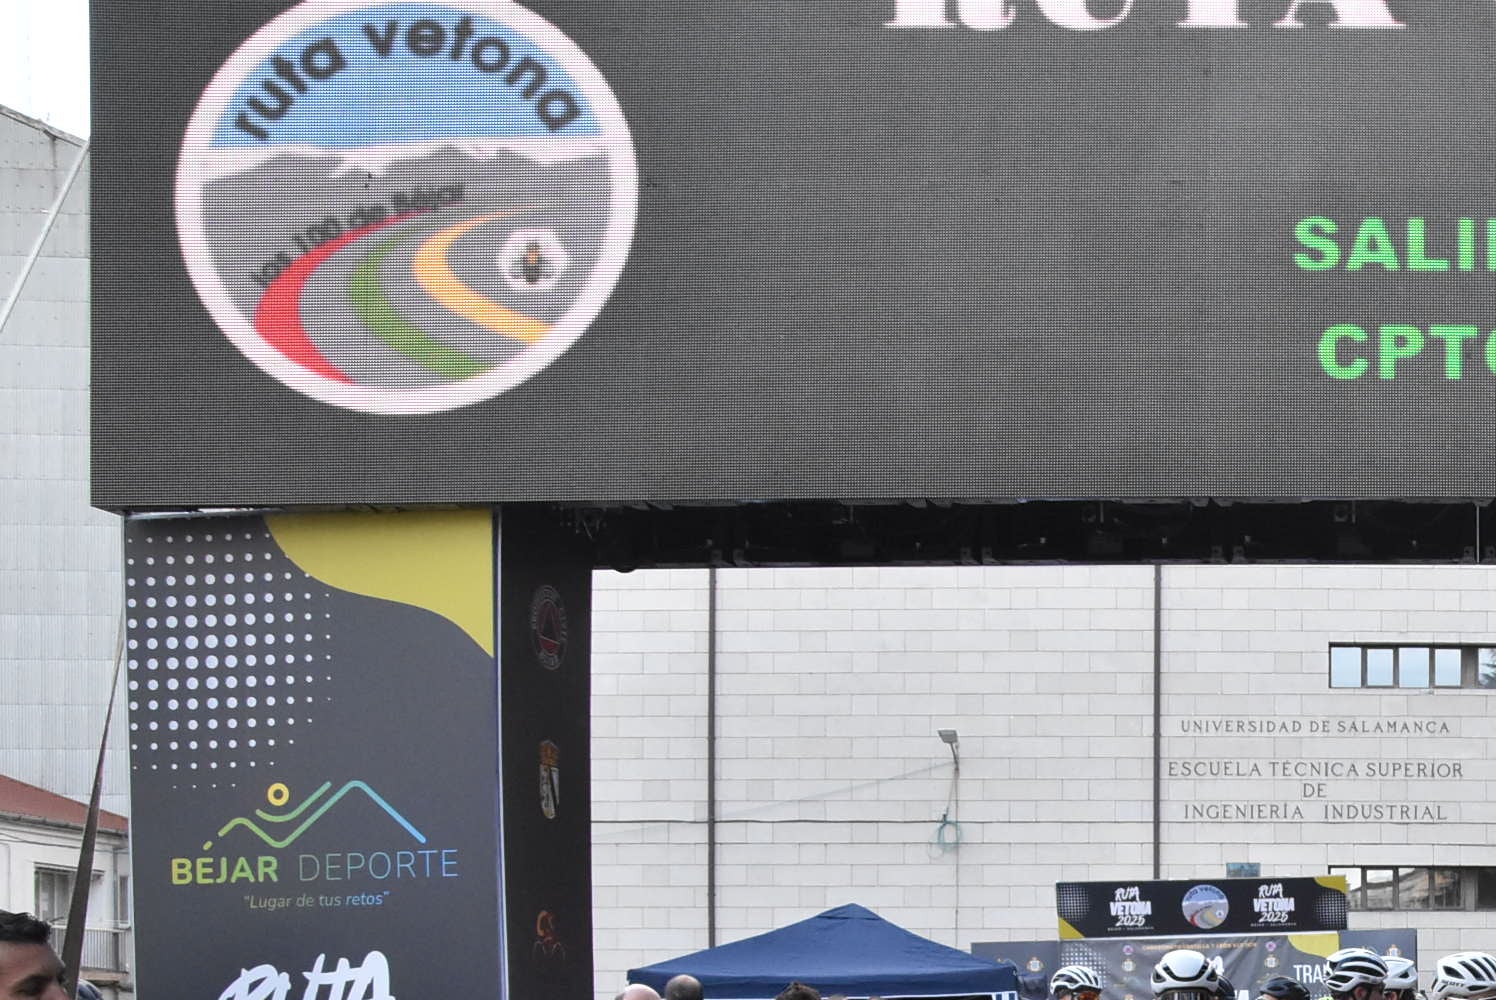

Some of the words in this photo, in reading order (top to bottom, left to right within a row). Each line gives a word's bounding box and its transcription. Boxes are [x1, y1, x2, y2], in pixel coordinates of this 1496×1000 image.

[235, 38, 346, 140] ruta
[363, 16, 582, 131] vetona
[1180, 720, 1302, 734] UNIVERSIDAD
[1309, 720, 1332, 734] DE
[1337, 720, 1450, 734] SALAMANCA
[1168, 761, 1262, 778] ESCUELA
[1366, 761, 1464, 779] SUPERIOR
[1302, 782, 1328, 799] DE
[1323, 803, 1449, 822] INDUSTRIAL
[171, 841, 279, 886] BÉJAR
[299, 848, 459, 883] DEPORTE
[295, 893, 315, 908] de
[318, 893, 342, 907] tus
[345, 890, 390, 906] retos"
[1114, 886, 1141, 902] RUTA
[1258, 882, 1284, 899] RUTA
[1109, 901, 1152, 916] VETONA
[1253, 897, 1296, 913] VETONA
